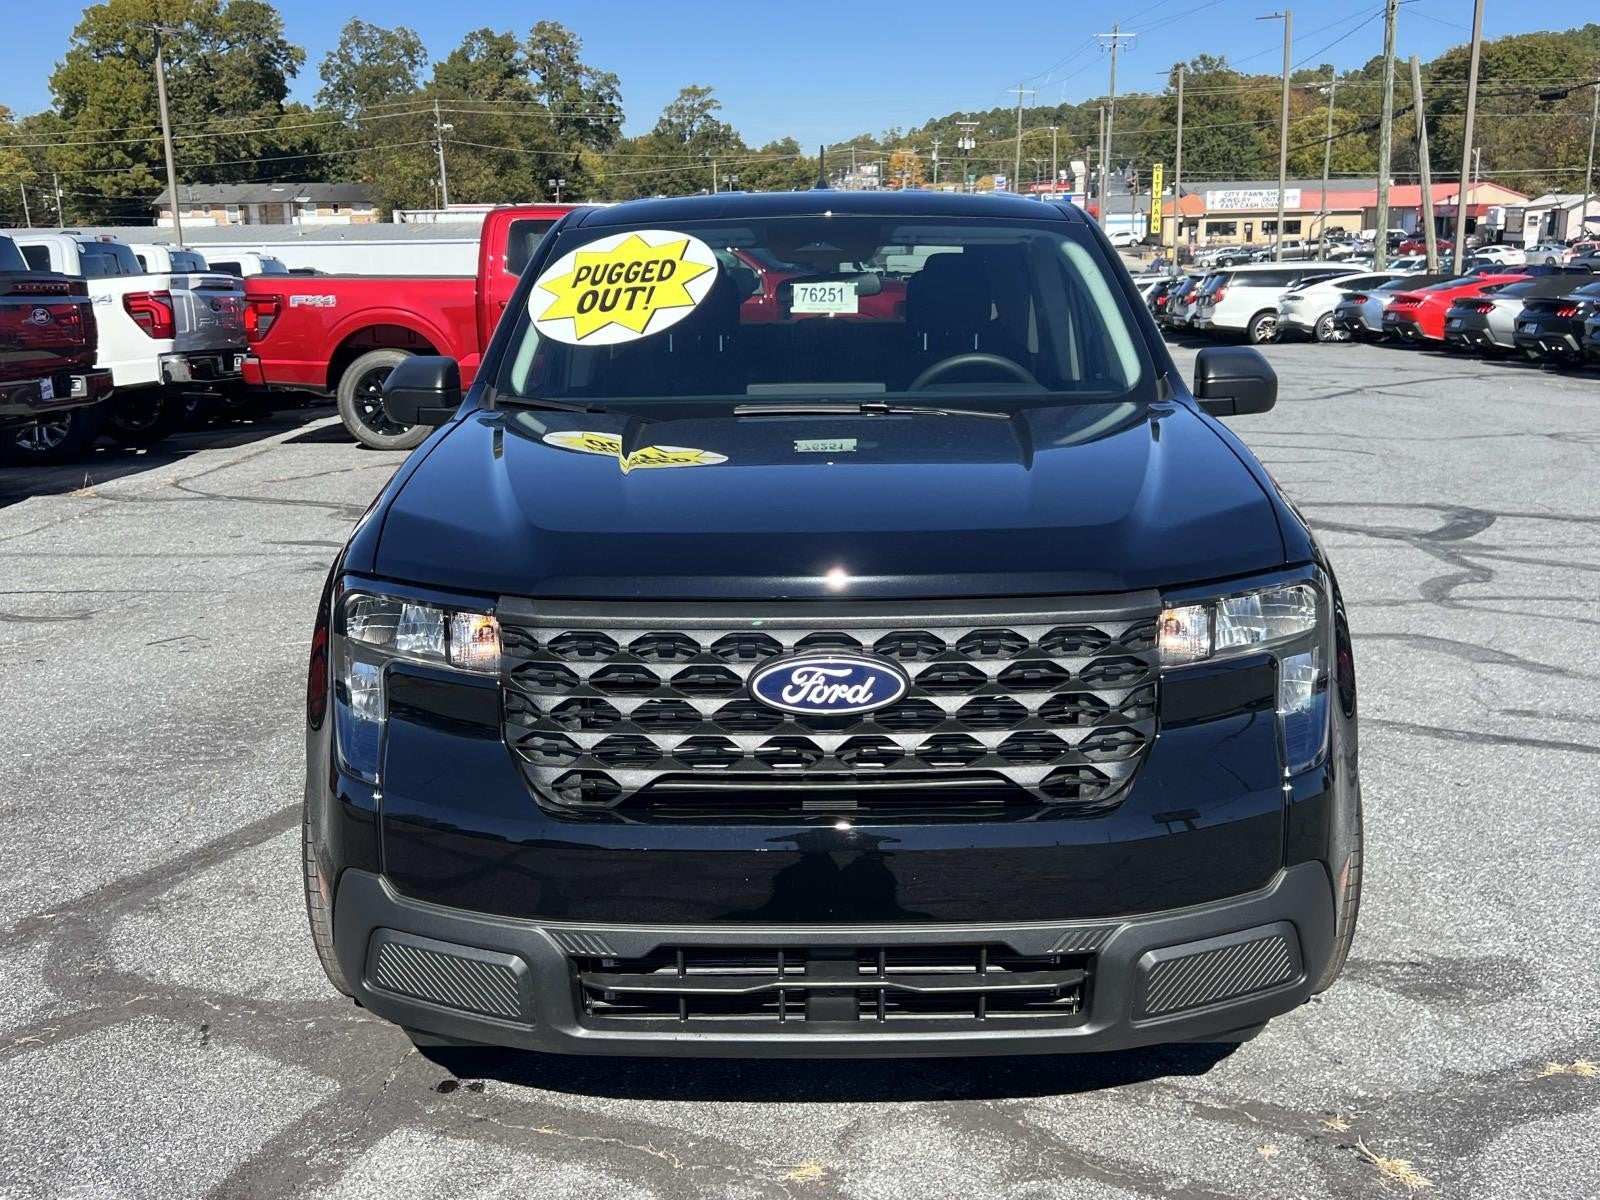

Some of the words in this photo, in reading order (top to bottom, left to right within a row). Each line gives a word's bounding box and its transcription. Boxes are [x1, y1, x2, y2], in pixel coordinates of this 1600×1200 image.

[1154, 165, 1162, 196] CITY
[571, 259, 676, 289] PUGGED
[289, 294, 336, 308] FX4
[576, 286, 657, 314] OUT!
[800, 287, 844, 303] 76251
[782, 666, 876, 704] Ford
